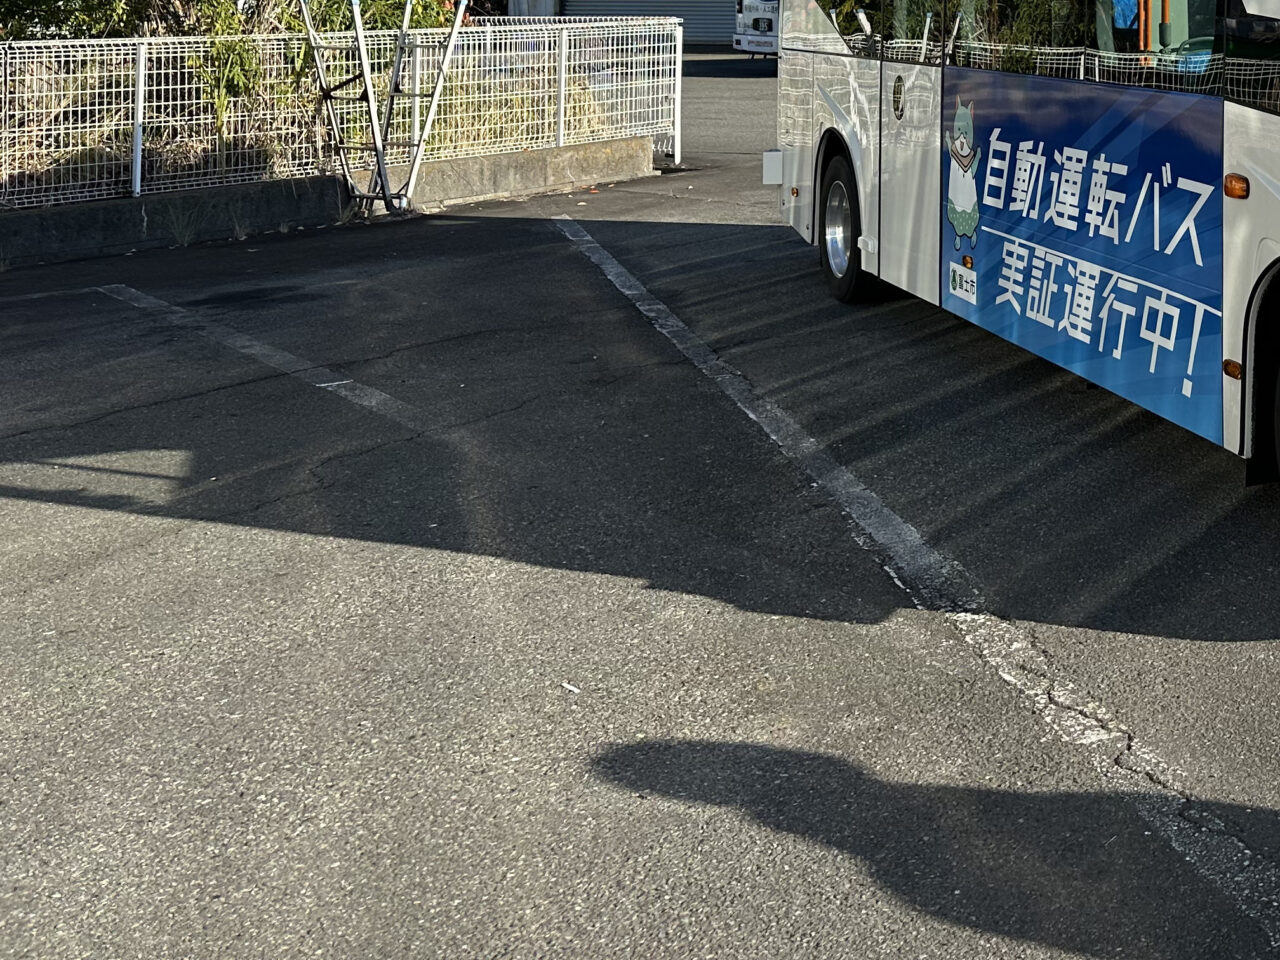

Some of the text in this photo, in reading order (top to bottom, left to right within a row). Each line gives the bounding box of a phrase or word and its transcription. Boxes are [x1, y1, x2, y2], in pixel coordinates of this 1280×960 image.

[982, 127, 1215, 267] 自動運転バス
[995, 240, 1204, 398] 実証運行中!
